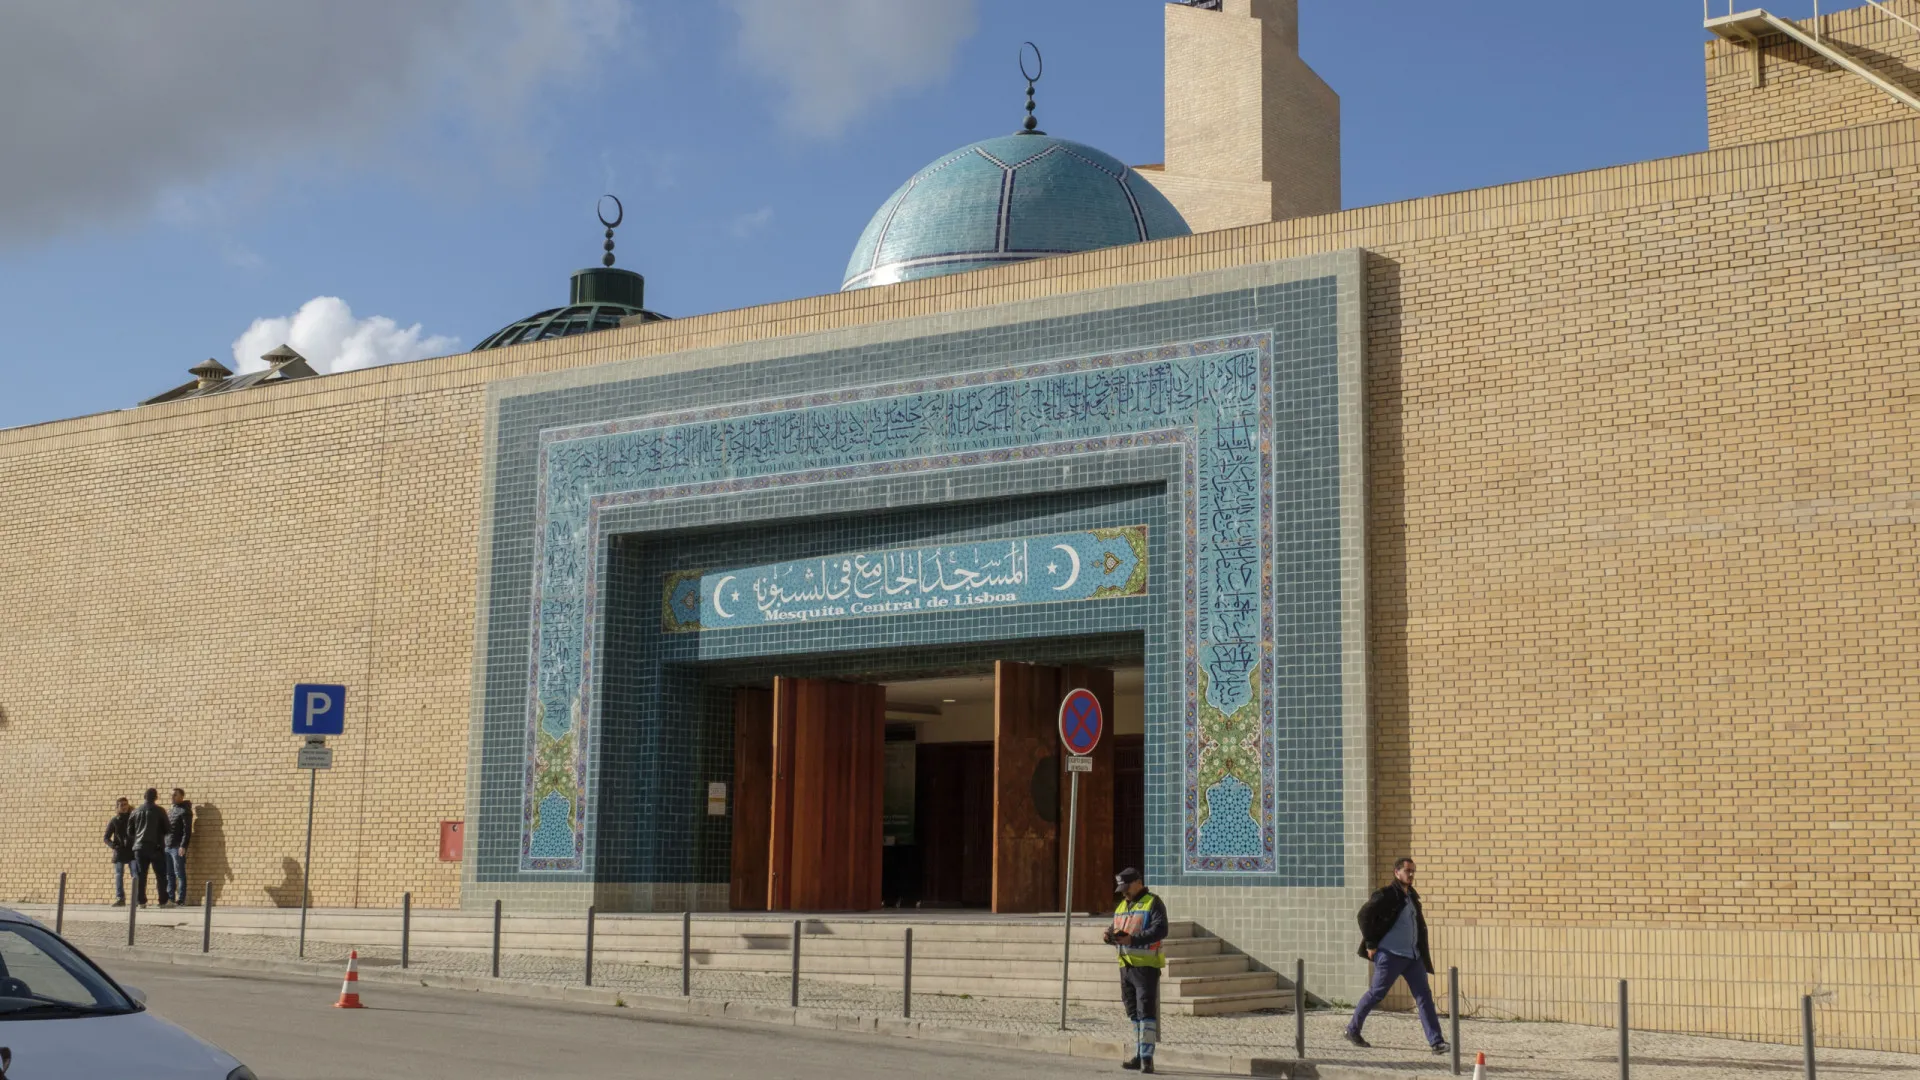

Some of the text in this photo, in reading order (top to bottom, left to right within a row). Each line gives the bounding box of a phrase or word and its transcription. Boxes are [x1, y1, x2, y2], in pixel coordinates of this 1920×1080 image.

[765, 591, 1017, 622] Mesquita Central de Lisboa
[306, 692, 332, 726] P
